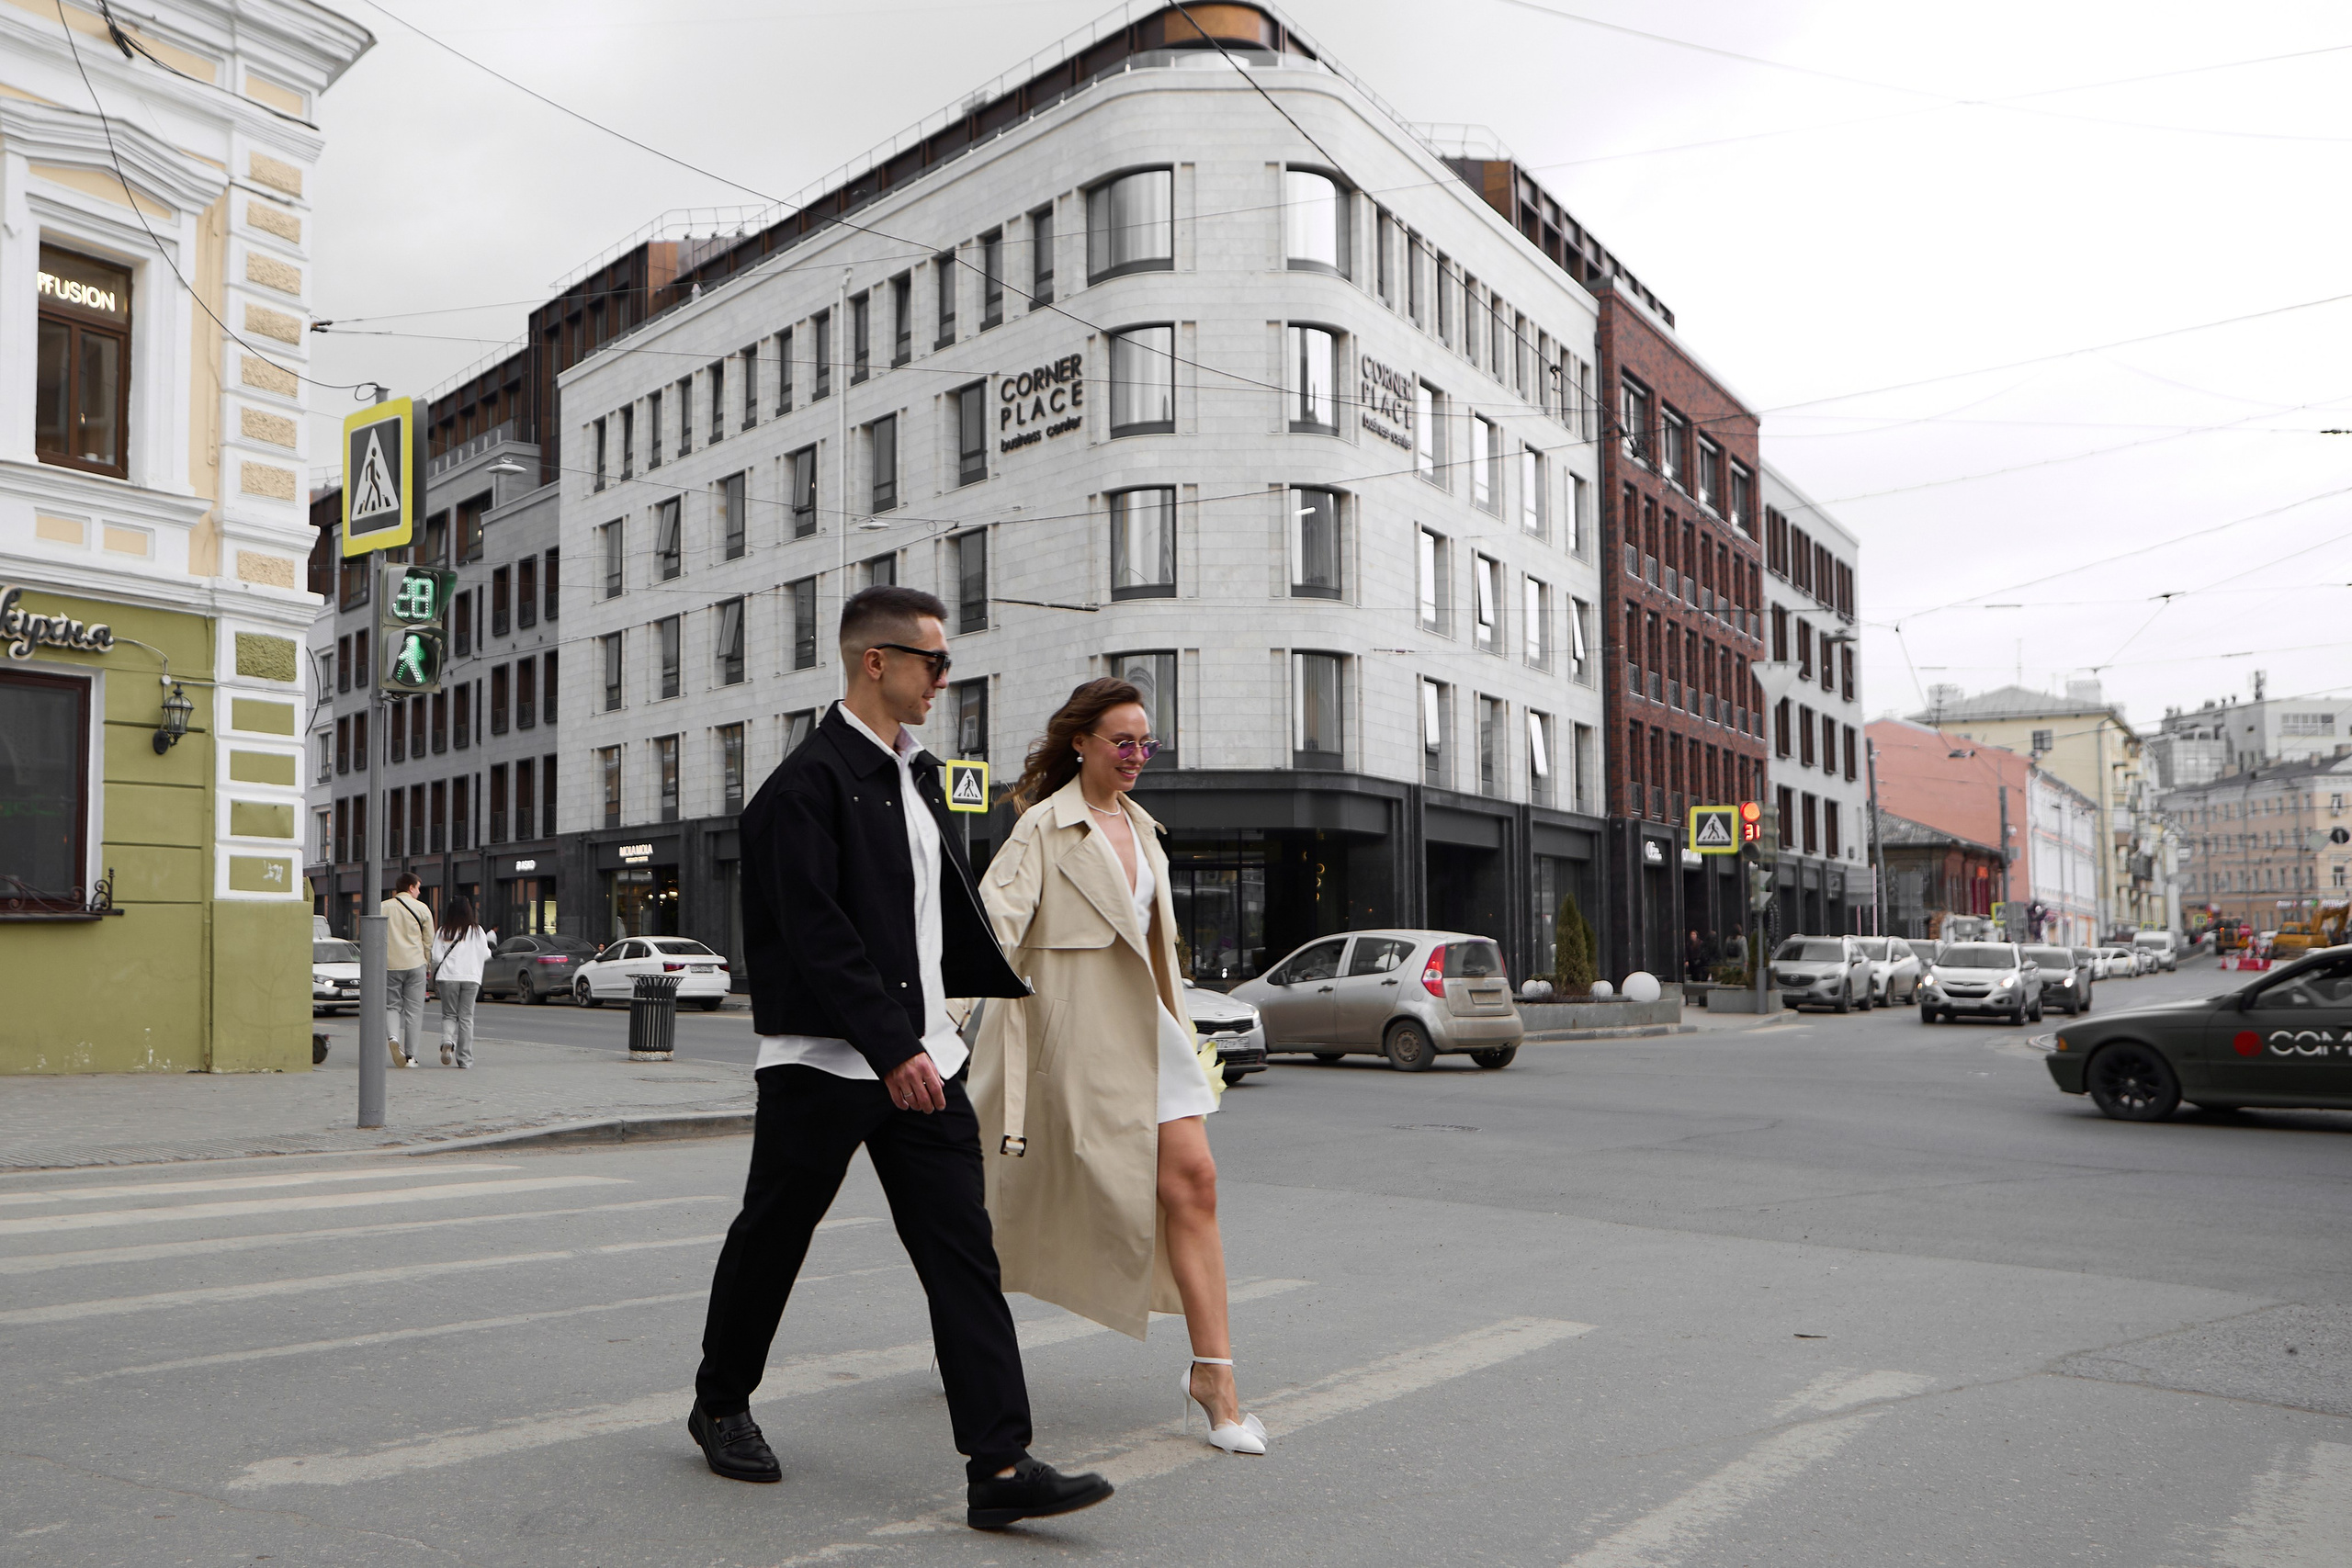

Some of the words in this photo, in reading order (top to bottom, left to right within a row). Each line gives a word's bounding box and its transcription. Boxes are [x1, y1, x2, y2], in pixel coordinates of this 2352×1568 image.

[1001, 353, 1082, 402] CORNER
[1362, 353, 1412, 402] CORNER
[1001, 379, 1082, 431] PLACE
[1362, 379, 1412, 430] PLACE
[1001, 429, 1042, 453] business
[1046, 415, 1082, 438] center
[392, 576, 435, 620] 28
[1744, 822, 1761, 841] 31
